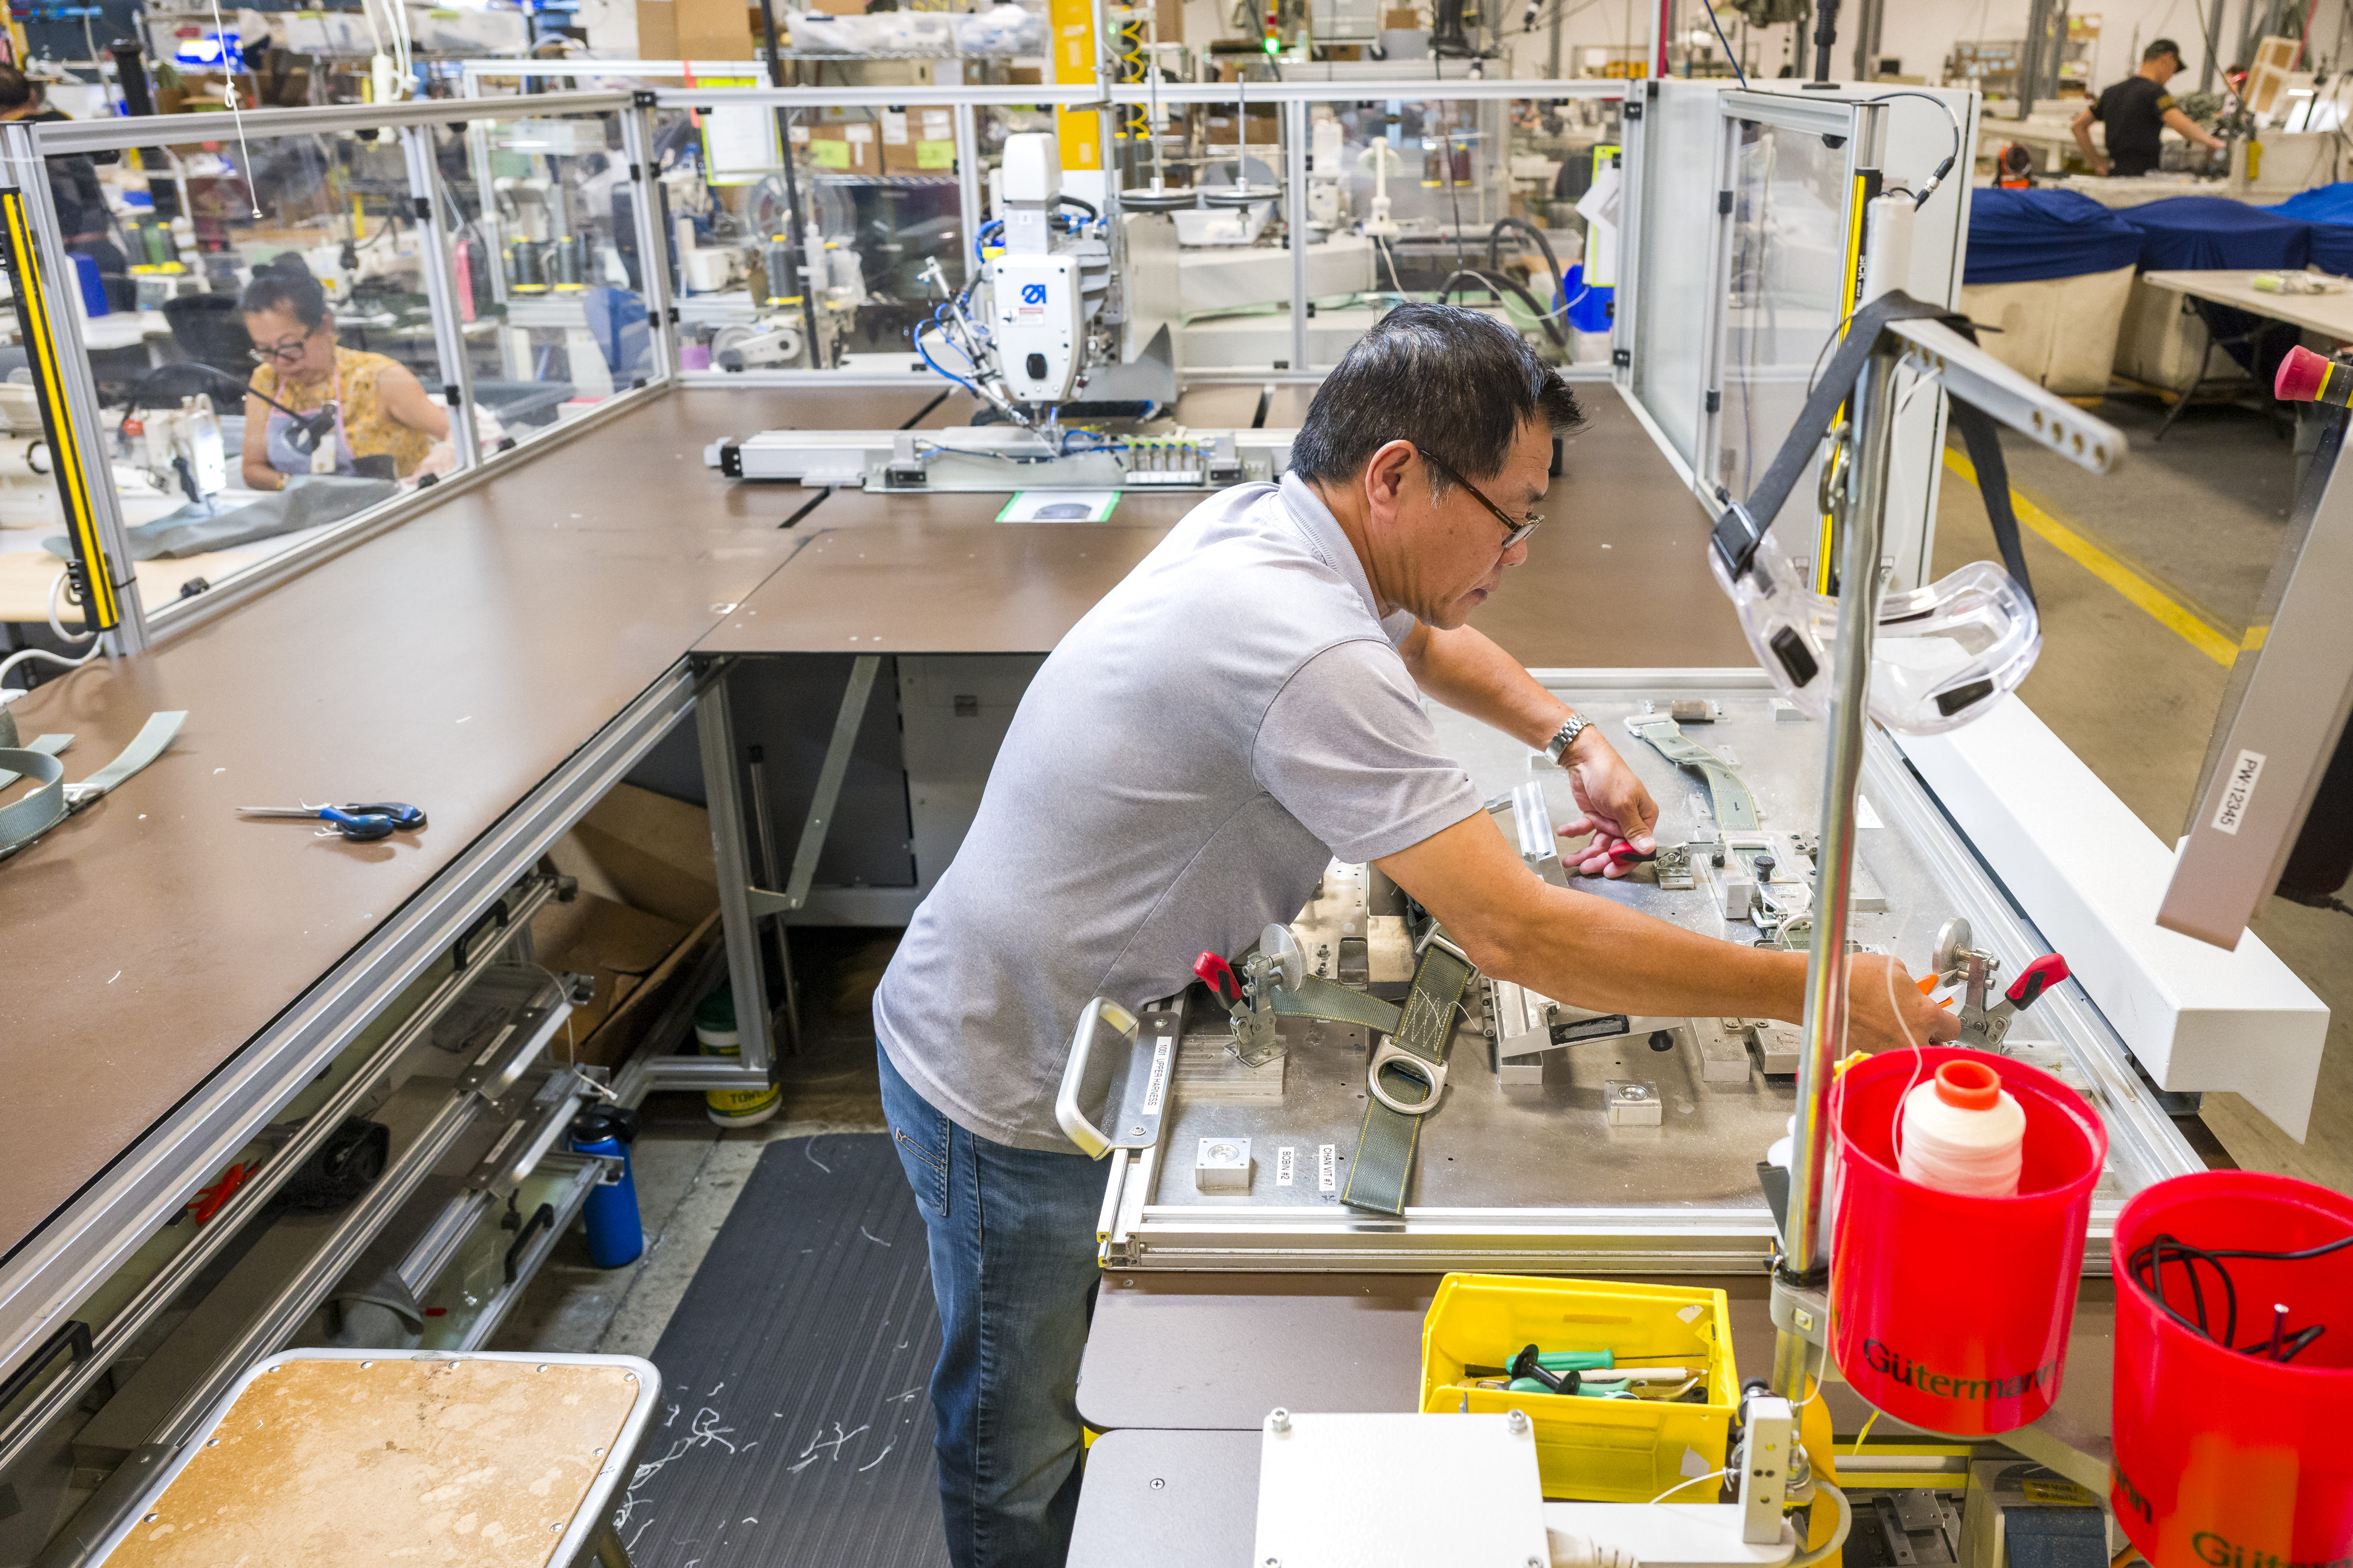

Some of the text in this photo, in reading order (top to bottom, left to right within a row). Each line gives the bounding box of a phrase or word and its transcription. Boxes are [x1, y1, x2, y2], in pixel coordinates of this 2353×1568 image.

[1148, 1045, 1167, 1106] 1001 UPPER HARNESS
[1281, 1151, 1291, 1170] BOBIN
[1323, 1147, 1332, 1165] CHAN
[1324, 1167, 1332, 1177] VIT
[1864, 1339, 2056, 1399] Gütermann
